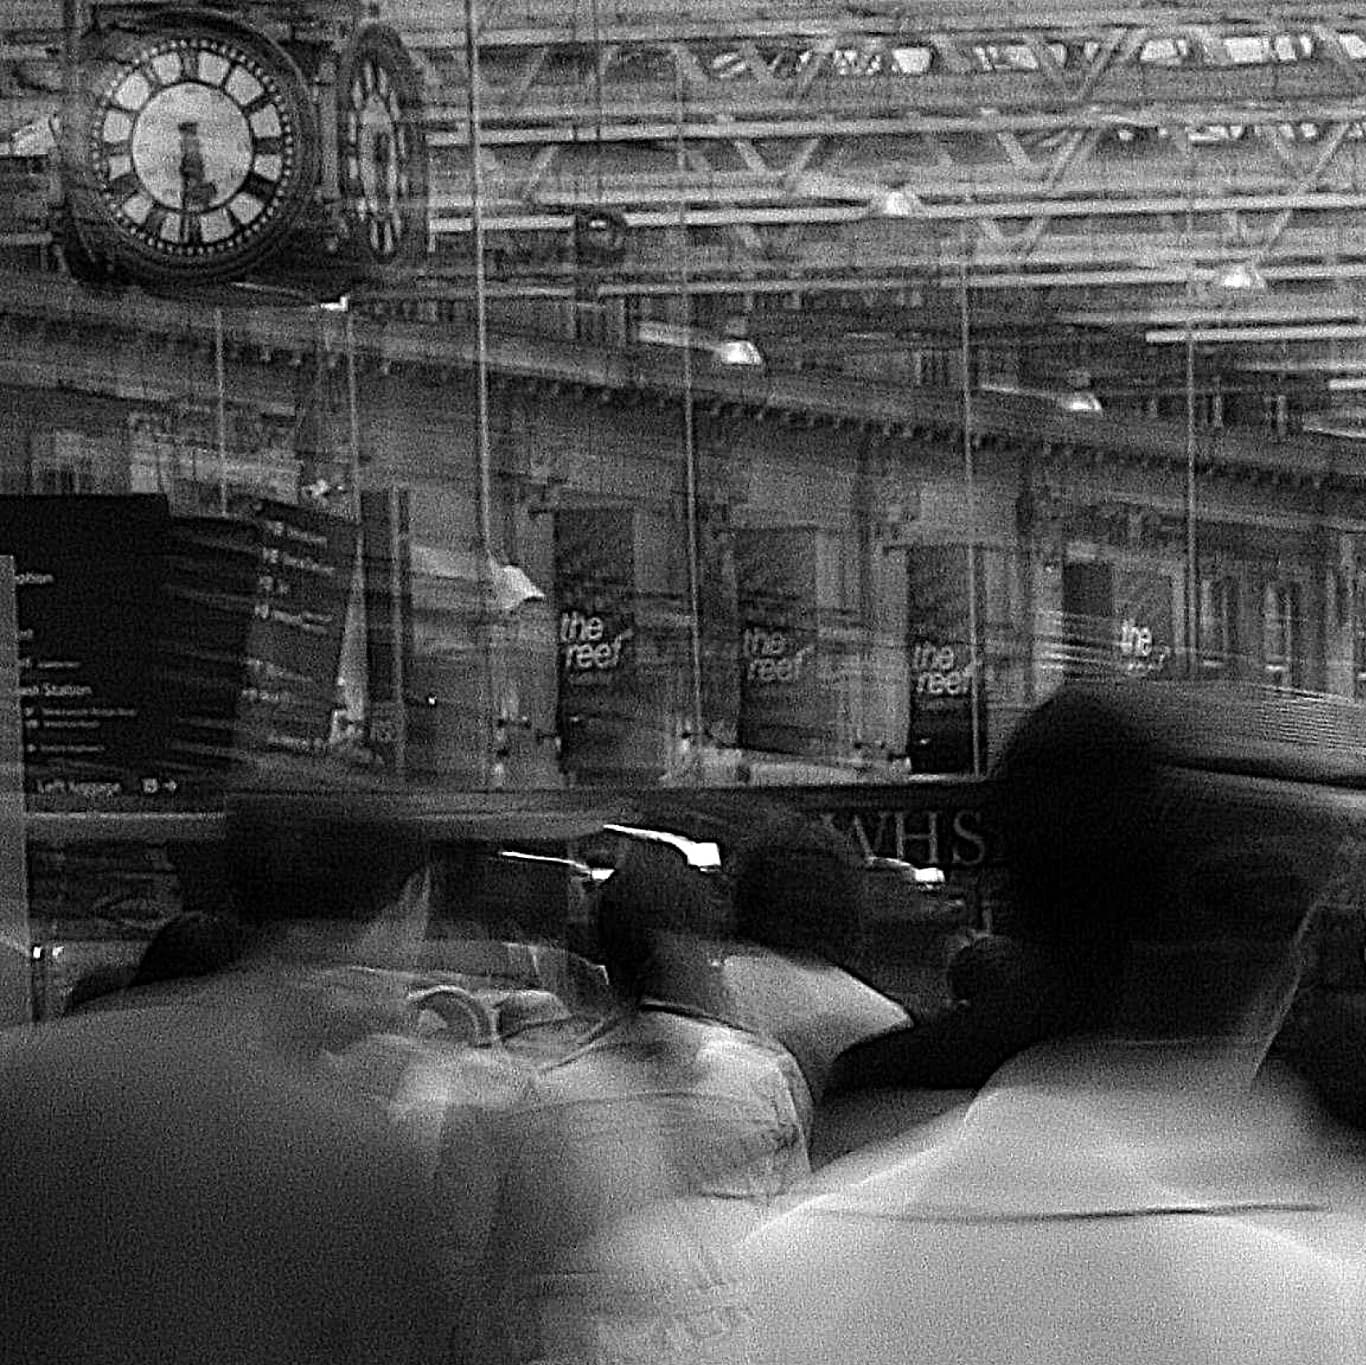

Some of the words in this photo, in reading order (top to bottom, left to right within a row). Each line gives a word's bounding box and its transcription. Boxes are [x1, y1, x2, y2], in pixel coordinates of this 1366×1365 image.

[560, 611, 604, 642] the
[743, 627, 787, 658] the
[1121, 618, 1152, 656] the
[566, 628, 634, 669] reef
[748, 645, 815, 682] reef
[914, 640, 955, 671] the
[916, 660, 978, 695] reef
